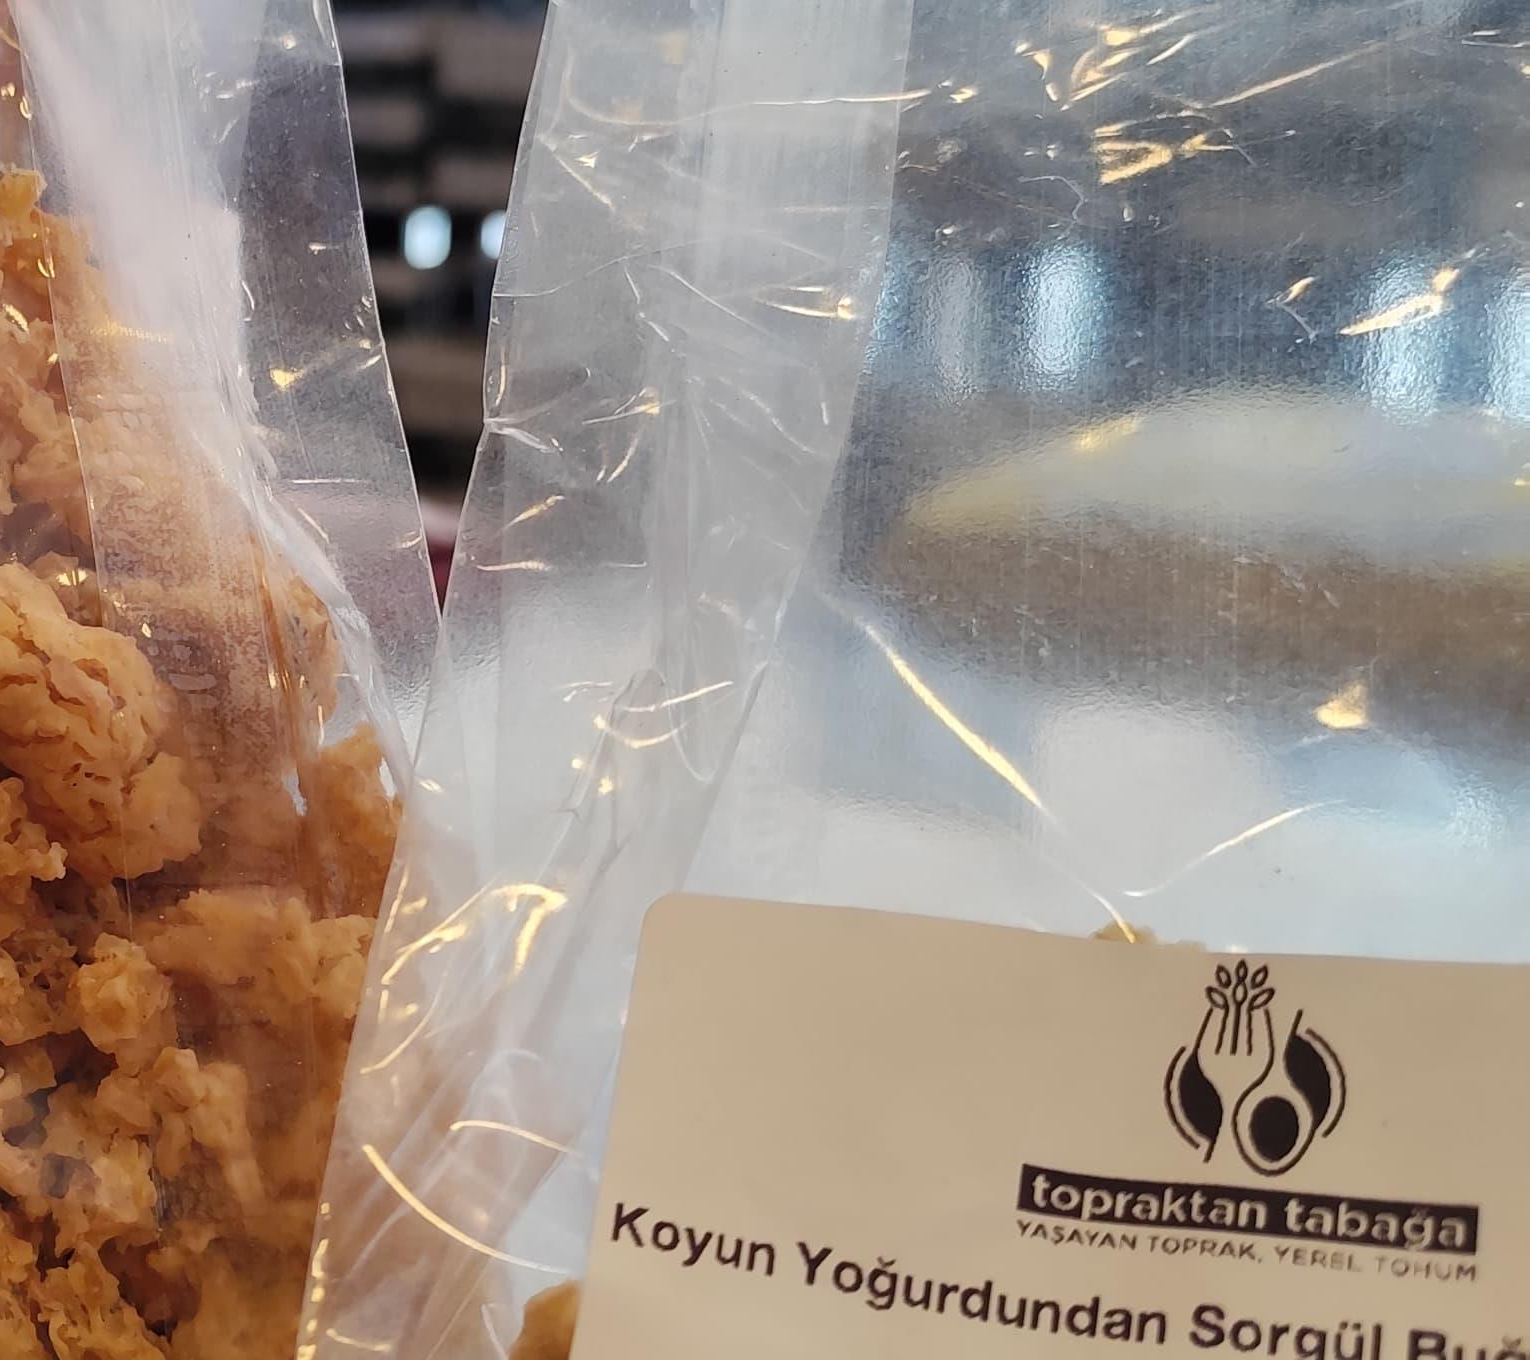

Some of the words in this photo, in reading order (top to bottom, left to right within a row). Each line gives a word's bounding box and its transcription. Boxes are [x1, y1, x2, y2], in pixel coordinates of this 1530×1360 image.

[1017, 1219, 1137, 1252] YAŞAYAN
[1149, 1234, 1263, 1265] TOPRAK,
[1274, 1245, 1363, 1273] YEREL
[1374, 1255, 1478, 1283] TOHUM
[1031, 1172, 1268, 1230] topraktan
[1284, 1197, 1466, 1252] tabağa
[611, 1201, 777, 1277] Koyun
[797, 1240, 1168, 1345] Yoğurdundan
